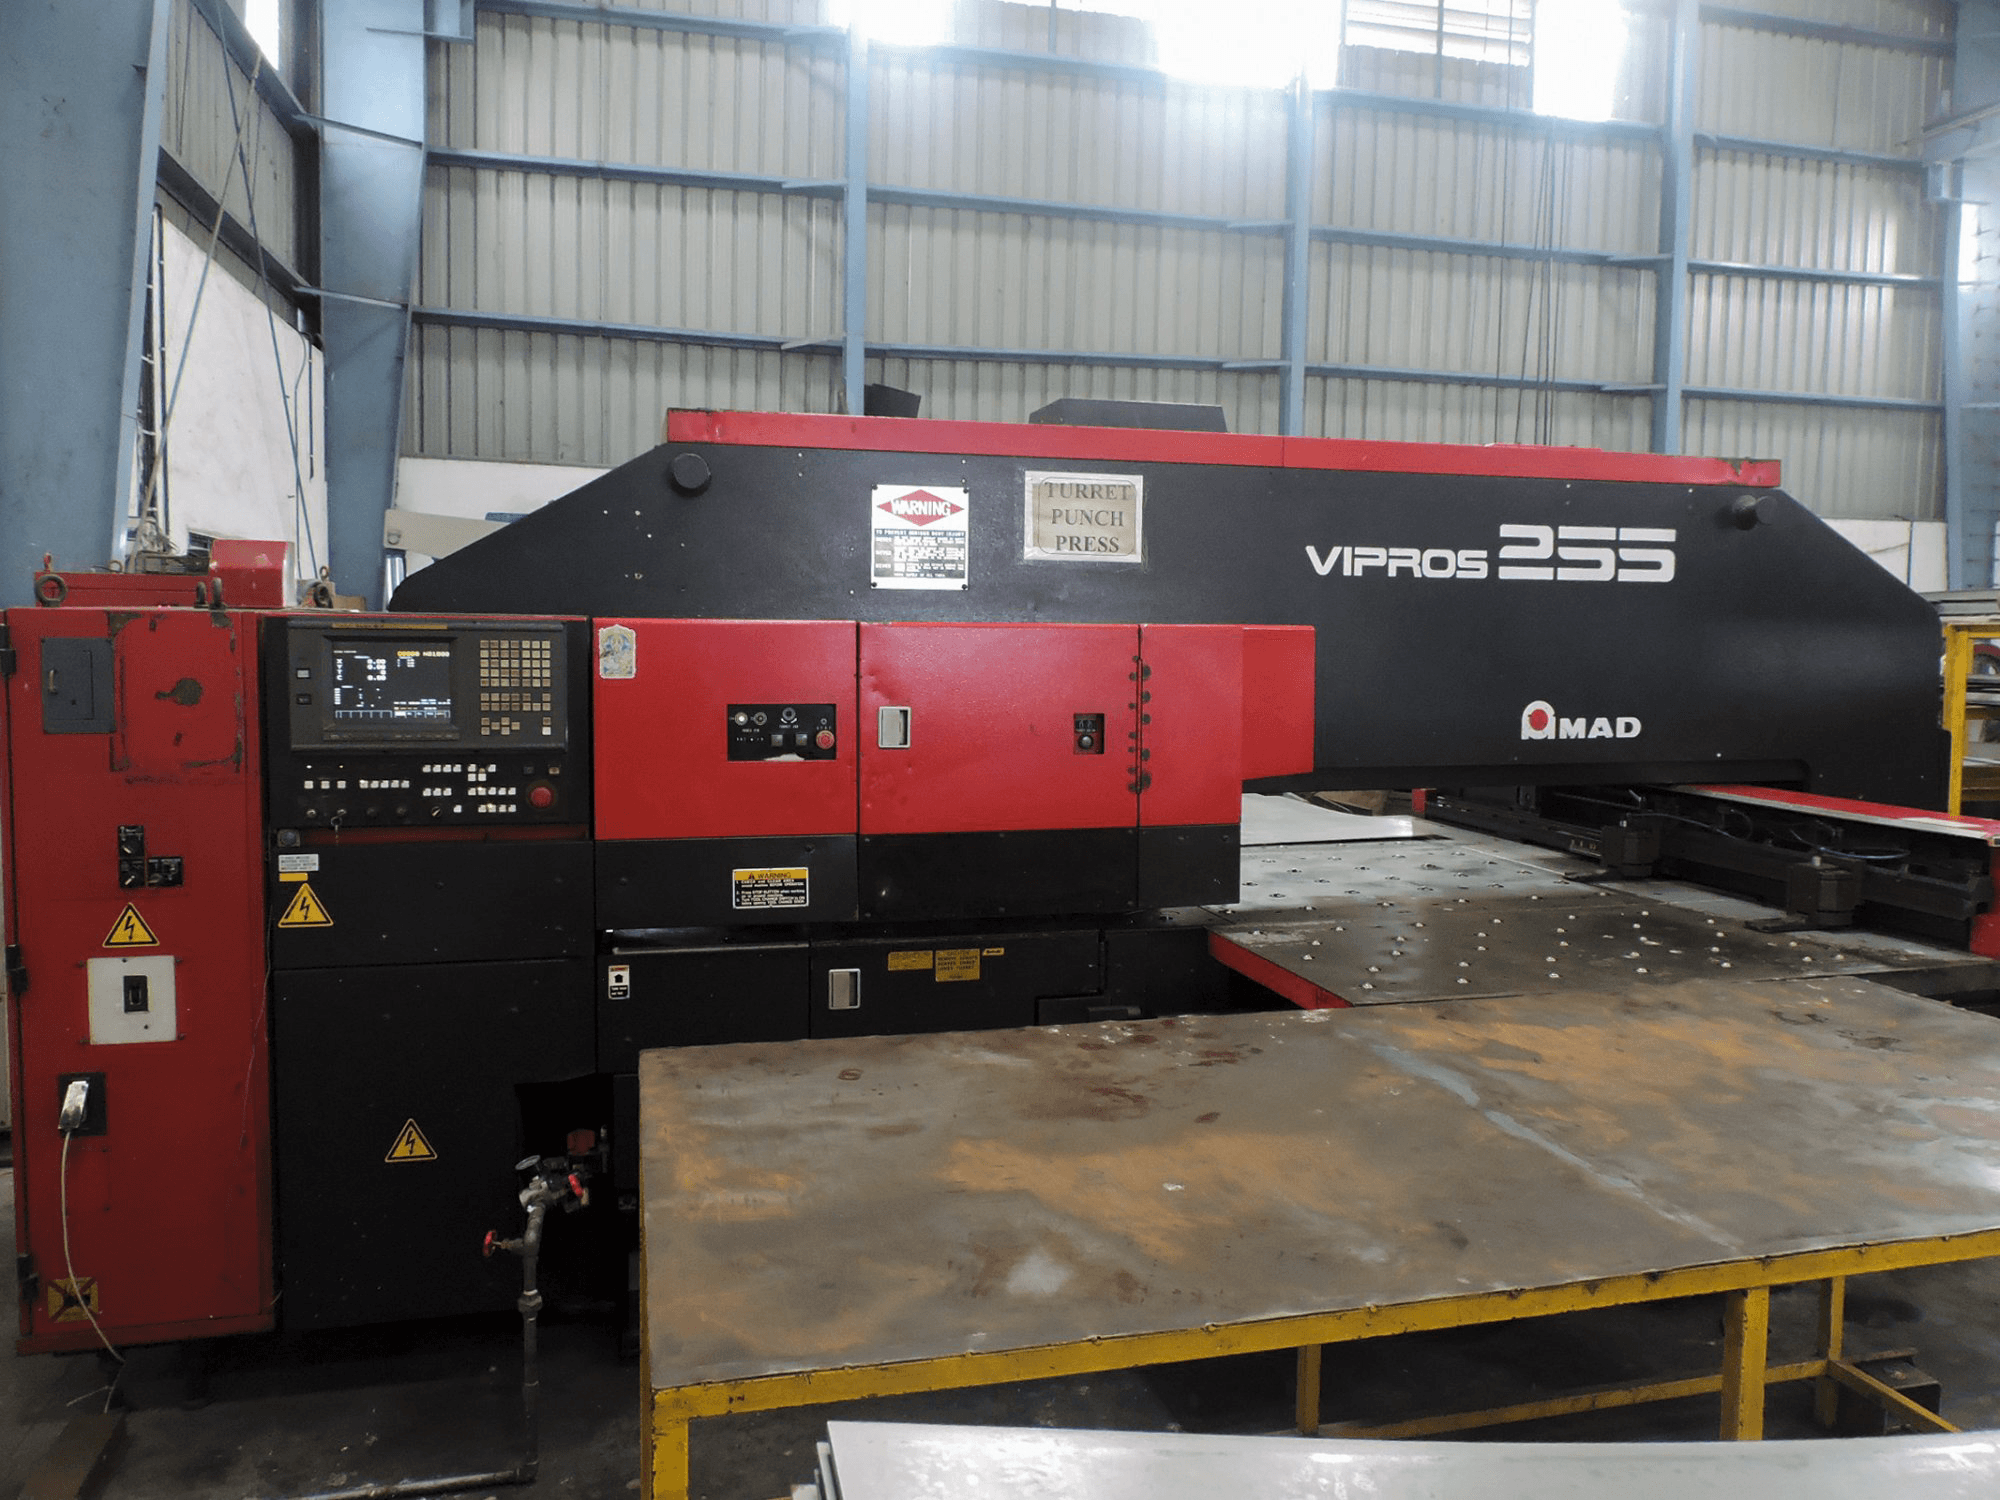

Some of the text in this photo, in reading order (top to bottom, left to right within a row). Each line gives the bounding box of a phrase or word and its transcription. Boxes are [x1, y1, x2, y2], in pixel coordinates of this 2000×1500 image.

[1045, 482, 1131, 500] TURRET
[891, 500, 950, 516] WARNING
[1051, 509, 1124, 527] PUNCH
[1056, 535, 1119, 553] PRESS
[1305, 524, 1677, 583] VIPROS 255
